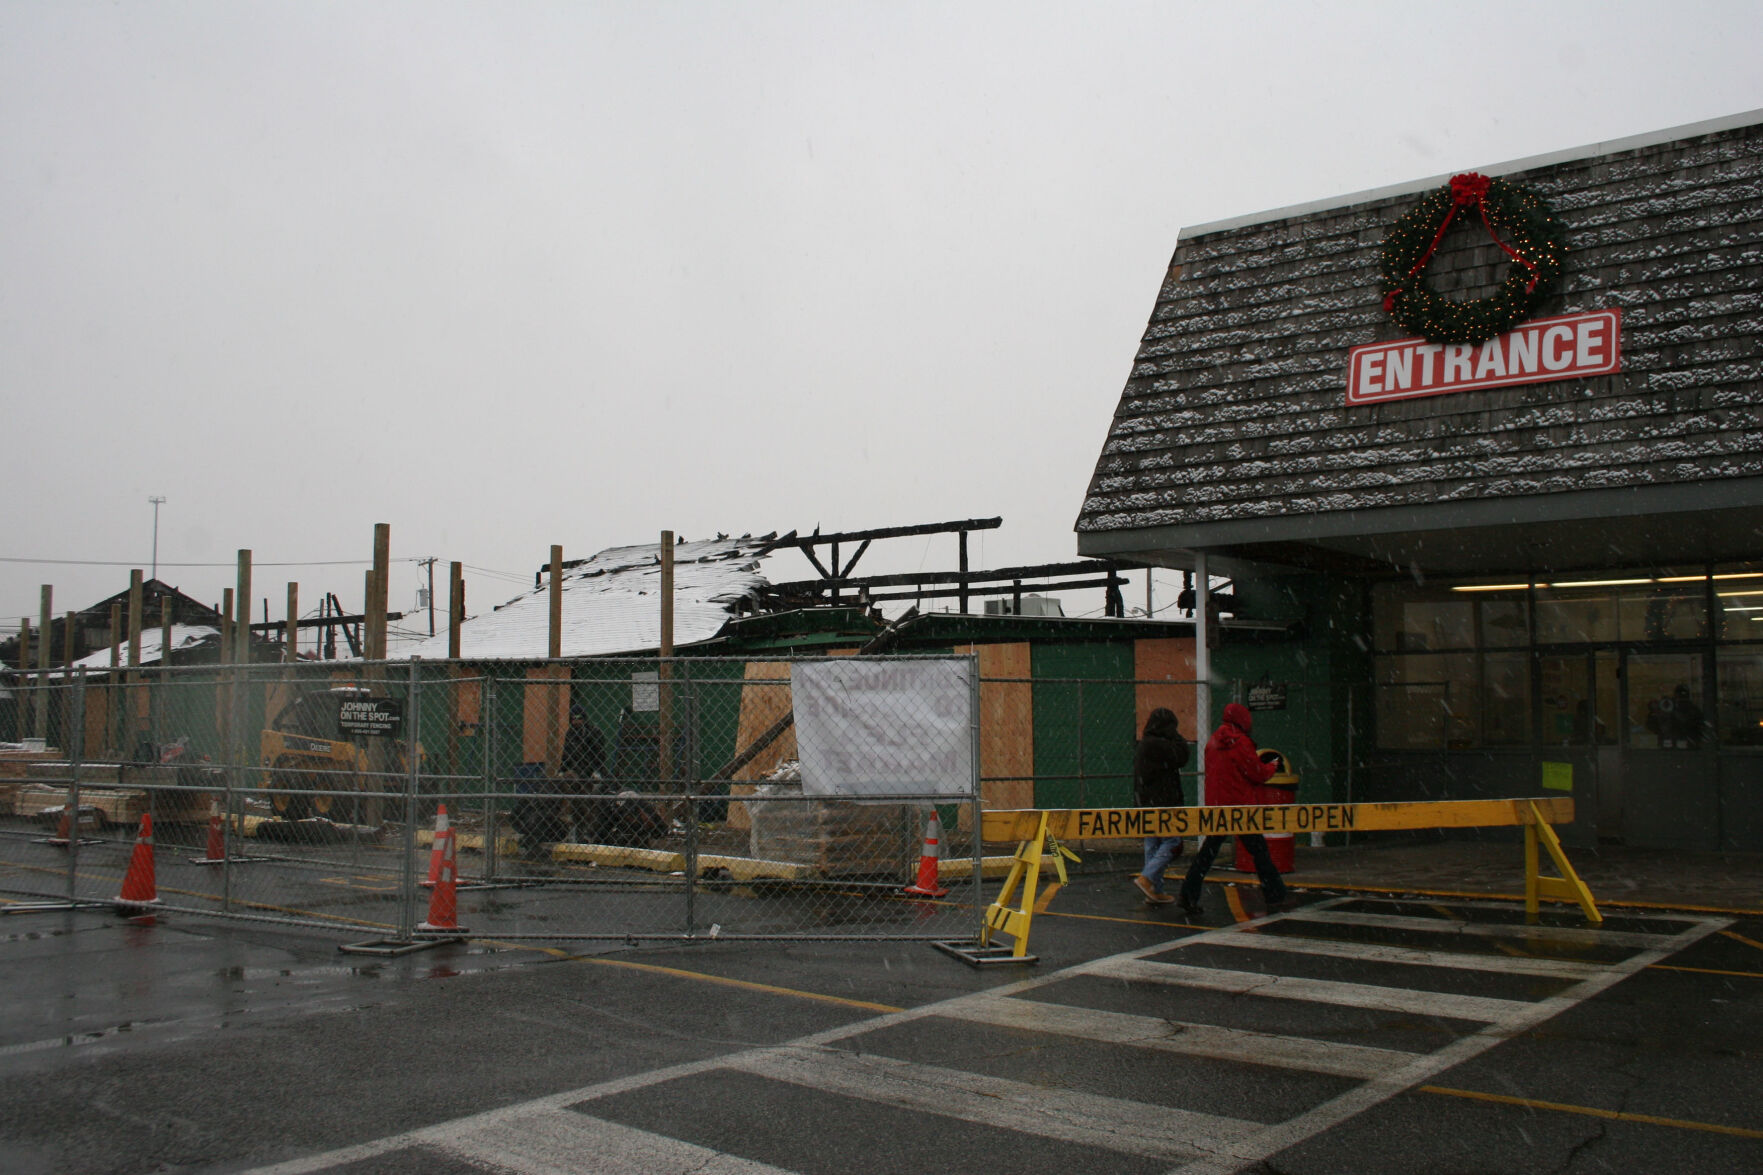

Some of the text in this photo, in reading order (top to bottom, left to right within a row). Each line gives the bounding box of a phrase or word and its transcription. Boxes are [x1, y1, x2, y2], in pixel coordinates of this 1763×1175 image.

[1359, 319, 1604, 395] ENTRANCE
[340, 712, 352, 720] ON
[353, 712, 367, 720] THE
[341, 702, 377, 712] JOHNNY
[1198, 807, 1290, 833] MARKET
[1297, 805, 1355, 830] OPEN
